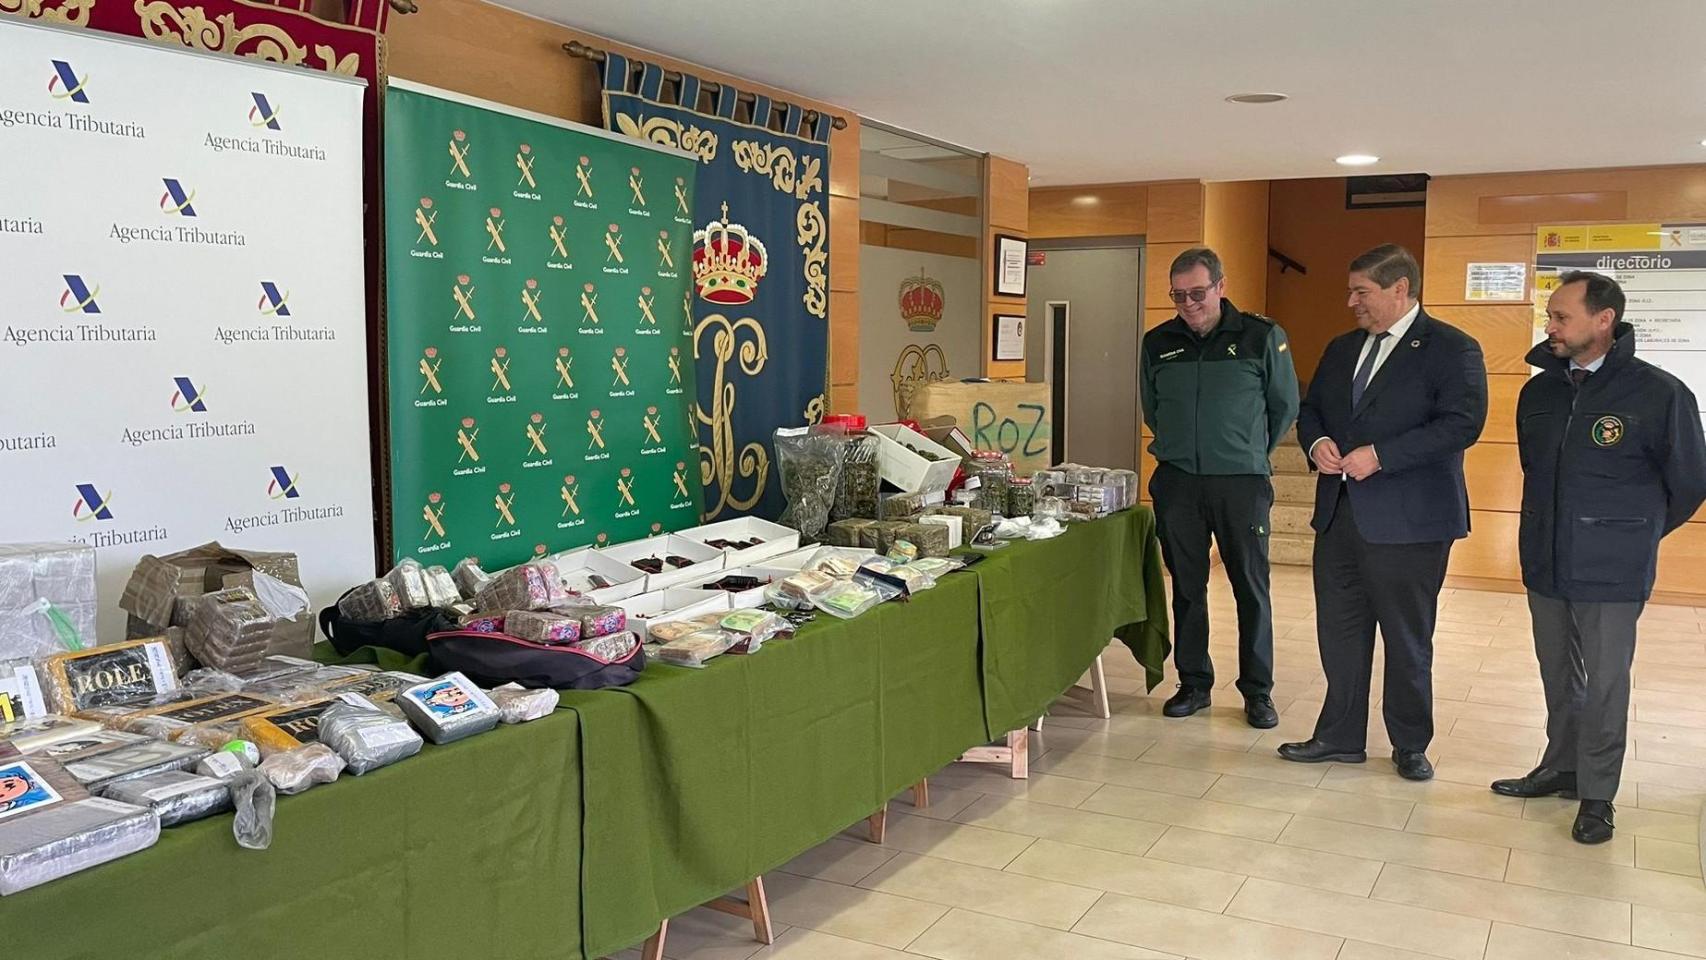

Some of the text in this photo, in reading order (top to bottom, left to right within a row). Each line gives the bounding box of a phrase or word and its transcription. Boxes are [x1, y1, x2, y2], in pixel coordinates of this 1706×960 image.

[65, 113, 144, 138] Tributaria
[204, 133, 325, 160] Agencia Tributaria
[110, 224, 245, 245] Agencia Tributaria
[411, 250, 431, 258] Guardia
[1597, 255, 1671, 269] directorio
[4, 325, 156, 346] Agencia Tributaria
[215, 325, 335, 344] Agencia Tributaria
[122, 421, 255, 446] Agencia Tributaria
[454, 468, 473, 476] Guardia
[225, 504, 343, 534] Agencia Tributaria
[89, 525, 167, 548] Tributaria
[418, 545, 439, 554] Guardia
